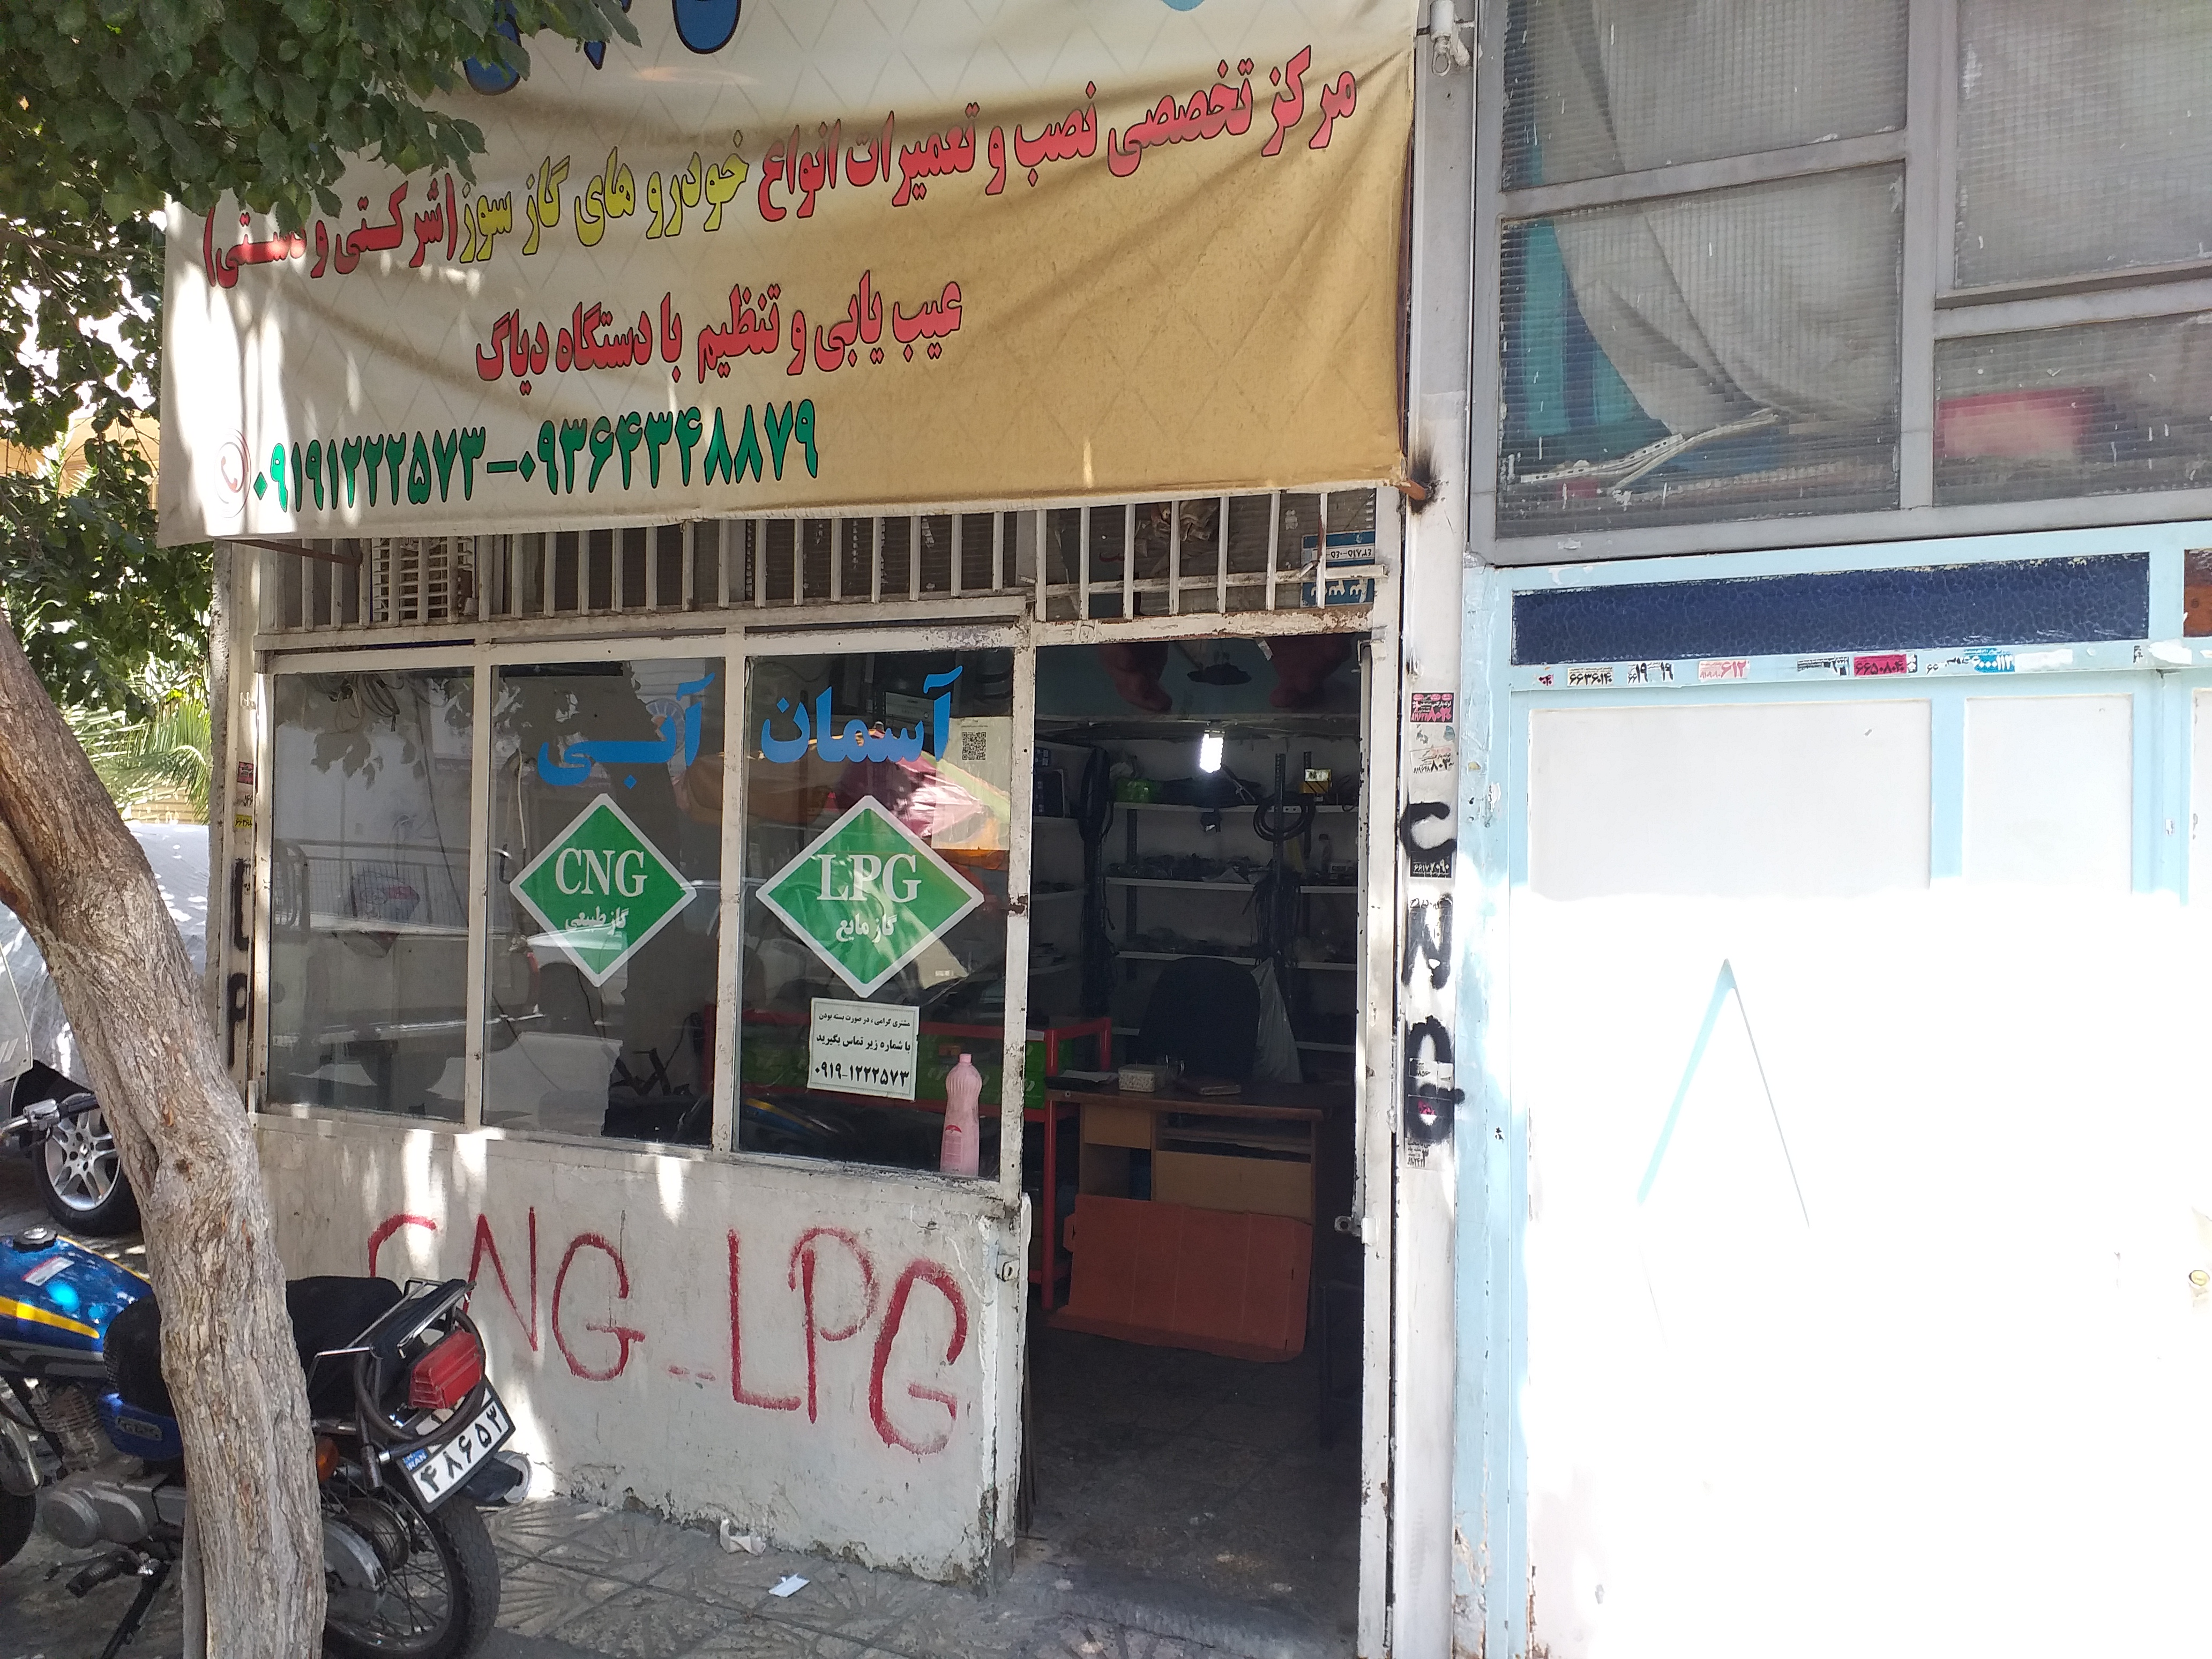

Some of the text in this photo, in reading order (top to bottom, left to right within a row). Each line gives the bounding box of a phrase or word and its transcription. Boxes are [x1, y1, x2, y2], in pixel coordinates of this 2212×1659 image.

[1013, 80, 1098, 188] نصب
[1107, 58, 1254, 178] تخصصی
[1261, 46, 1357, 158] مرکز
[573, 146, 636, 246] های
[646, 129, 750, 240] خودرو
[757, 118, 841, 223] انواع
[844, 103, 981, 208] تعمیرات
[984, 125, 1007, 196] و
[310, 219, 330, 279] و
[459, 183, 512, 264] سوز
[521, 154, 570, 256] گاز
[475, 270, 963, 397] عیب یابی و تنظیم با دستگاه دیاگ
[537, 672, 715, 789] آبی
[760, 664, 965, 764] آسمان
[554, 848, 648, 897] CNG
[817, 853, 922, 903] LPG
[607, 906, 629, 936] گاز
[836, 913, 898, 943] گاز مایع
[816, 1034, 910, 1054] با شماره زیر تماس بگیرید
[819, 1012, 832, 1021] بودن
[833, 1013, 845, 1022] بسته
[845, 1015, 862, 1024] صورت
[892, 1019, 910, 1028] مشتری
[727, 1227, 968, 1455] LPG
